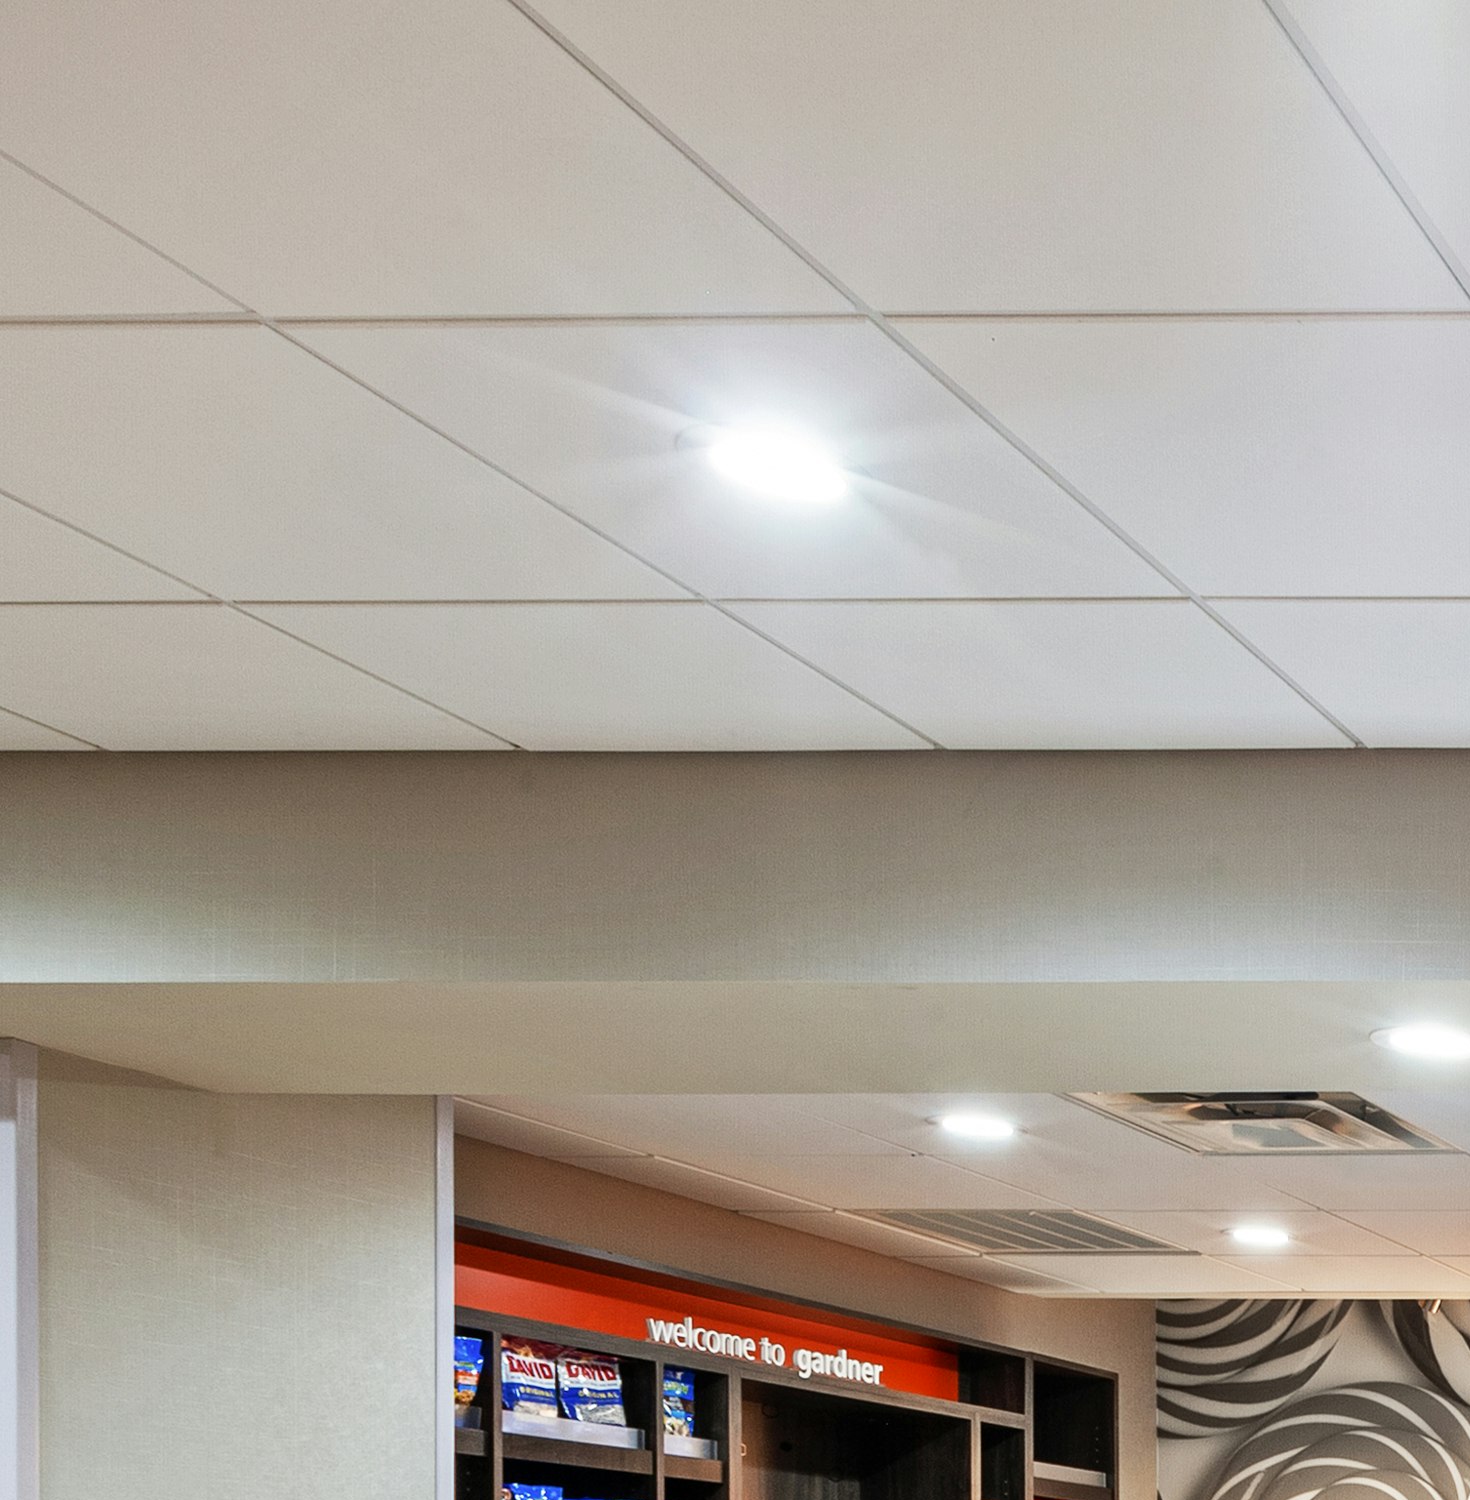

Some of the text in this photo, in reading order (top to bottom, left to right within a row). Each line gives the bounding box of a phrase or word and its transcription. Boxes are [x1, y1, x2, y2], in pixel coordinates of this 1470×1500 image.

[648, 1316, 883, 1385] welcome to gardner
